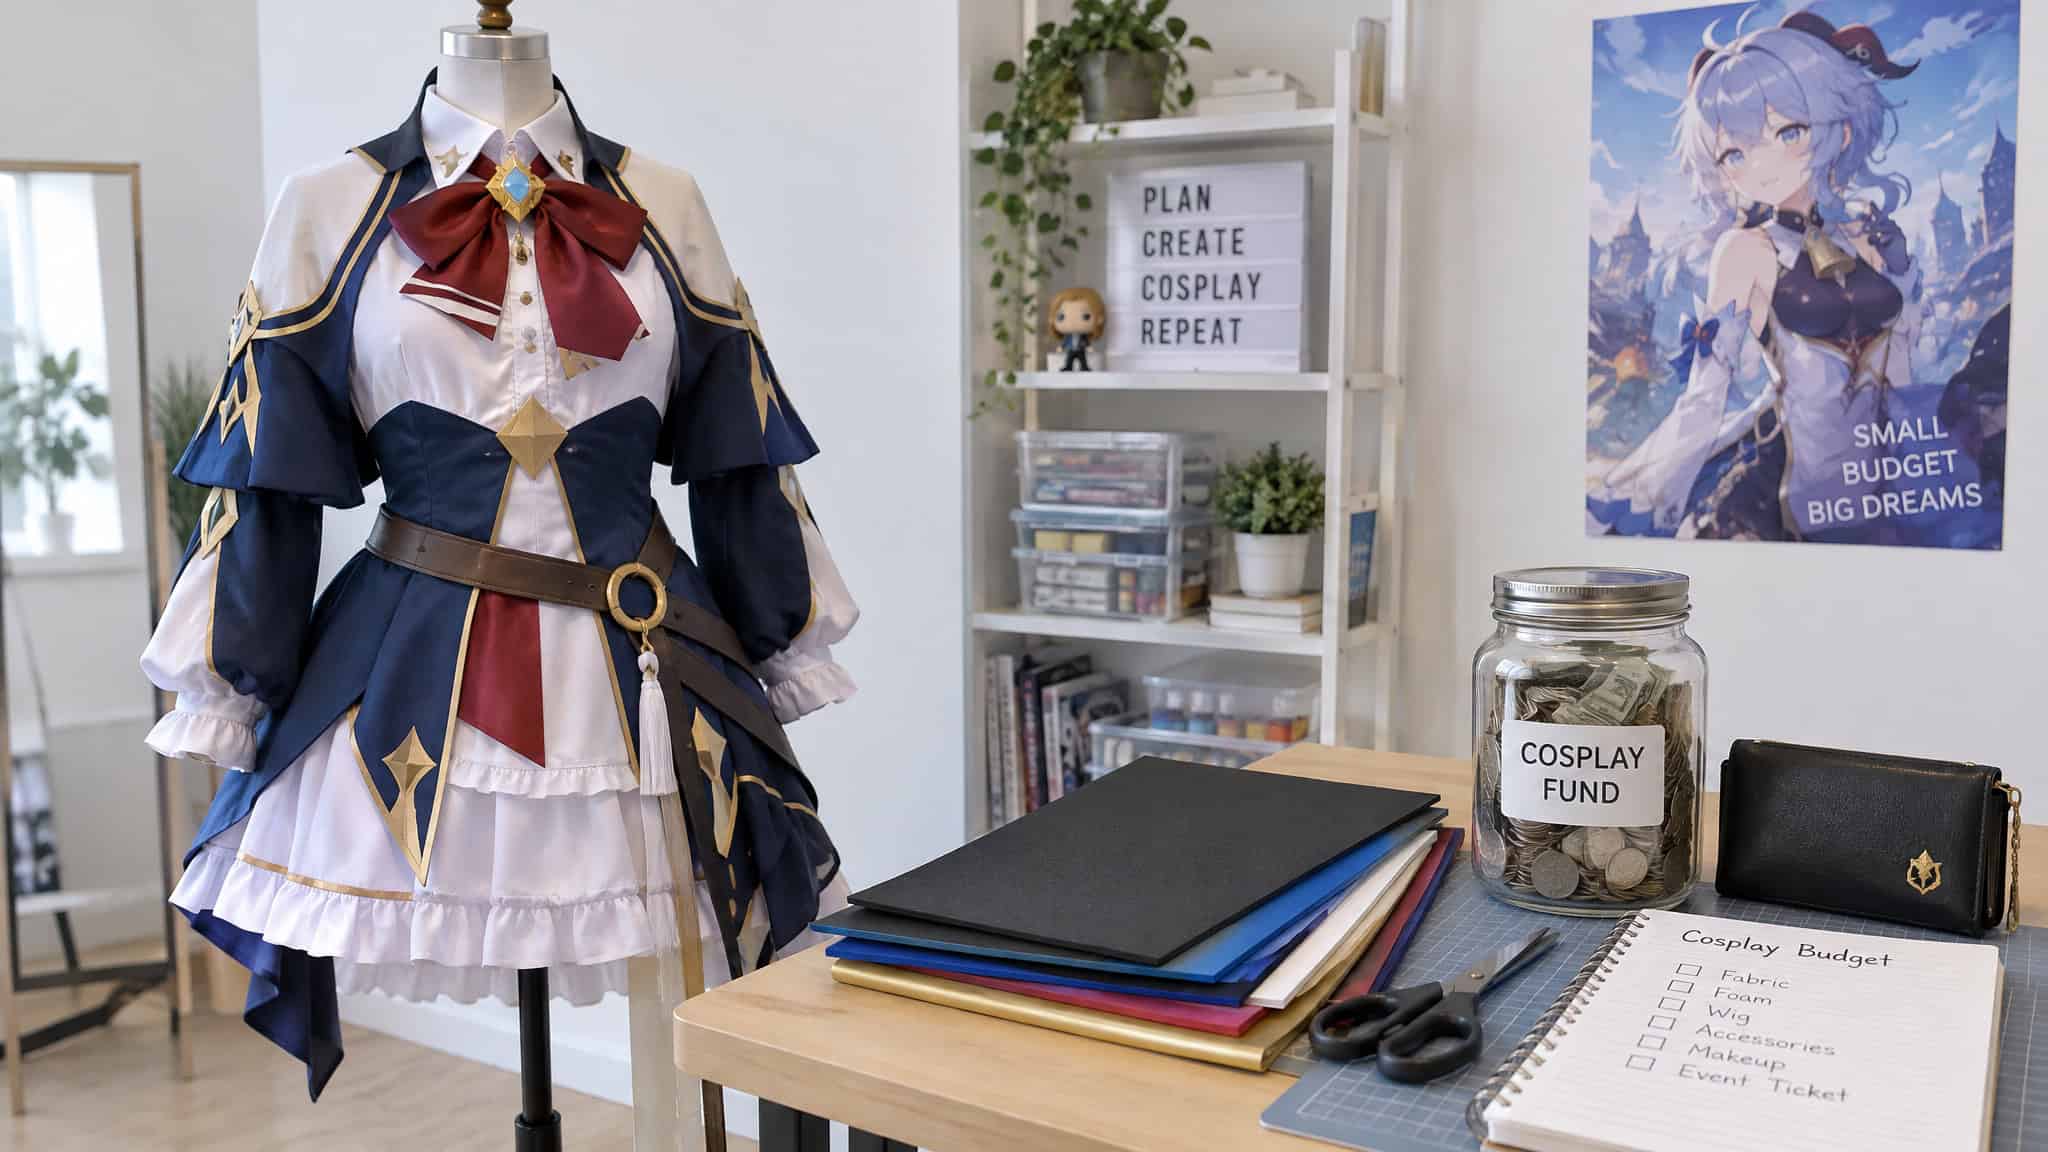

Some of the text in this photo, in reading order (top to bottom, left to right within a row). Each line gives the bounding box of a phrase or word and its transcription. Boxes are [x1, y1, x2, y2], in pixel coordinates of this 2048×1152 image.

[1143, 184, 1211, 214] PLAN
[1142, 227, 1245, 258] CREATE
[1141, 272, 1262, 301] COSPLAY
[1141, 317, 1243, 345] REPEAT
[1853, 415, 1949, 448] SMALL
[1842, 449, 1958, 486] BUDGET
[1807, 483, 1983, 525] BIG DREAMS
[1520, 741, 1645, 770] COSPLAY
[1543, 777, 1620, 804] FUND
[1681, 929, 1894, 968] Cosplay Budget
[1721, 969, 1791, 990] Fabric
[1714, 987, 1772, 1006] Foam
[1708, 1004, 1751, 1026] Wig
[1696, 1024, 1836, 1056] Accessories
[1688, 1042, 1786, 1073] Makeup
[1679, 1064, 1849, 1102] Event Ticket
